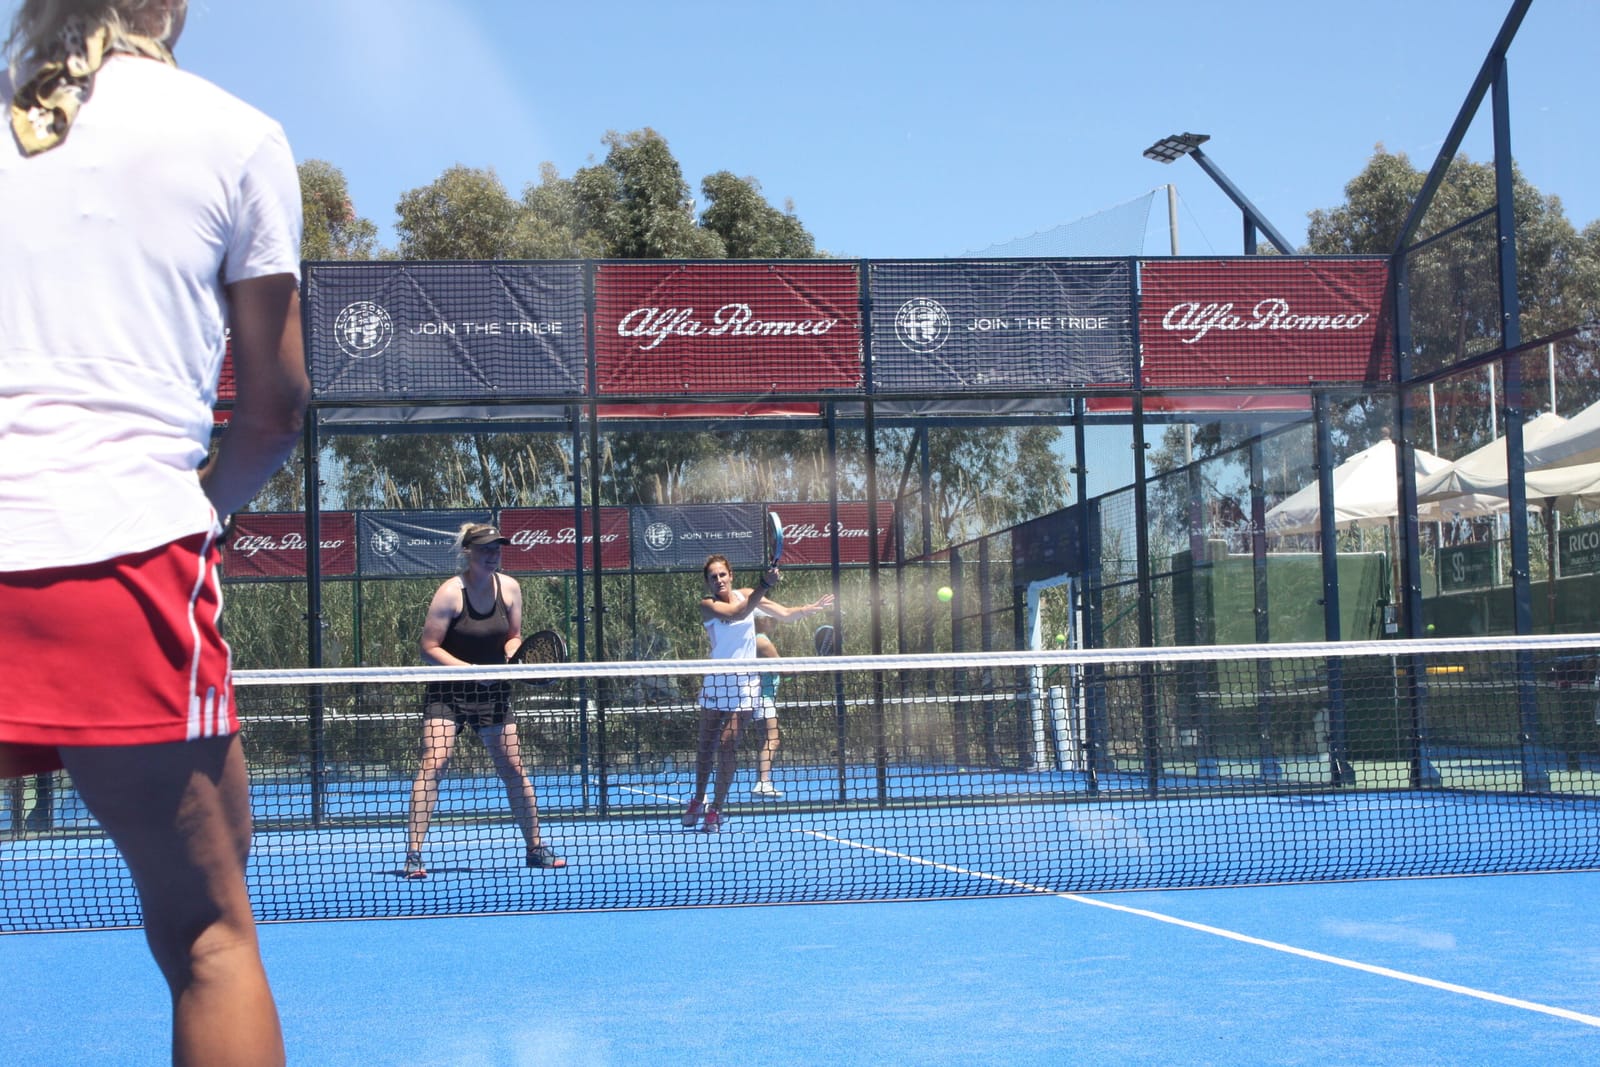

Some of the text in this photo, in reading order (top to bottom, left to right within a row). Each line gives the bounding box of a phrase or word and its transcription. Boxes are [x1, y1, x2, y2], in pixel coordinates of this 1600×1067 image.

[410, 321, 562, 335] JOIN THE TRIBE
[617, 303, 838, 350] Alfa Romeo
[967, 317, 1110, 331] JOIN THE TRIBE
[1162, 298, 1370, 344] Alfa Romeo
[407, 538, 430, 546] JOIN
[510, 527, 619, 552] Alfa Rmeo
[680, 531, 702, 540] JOIN
[704, 531, 723, 540] THE
[782, 523, 821, 545] Alfa
[1569, 531, 1599, 552] RICO
[233, 532, 345, 558] Alfa Roeo
